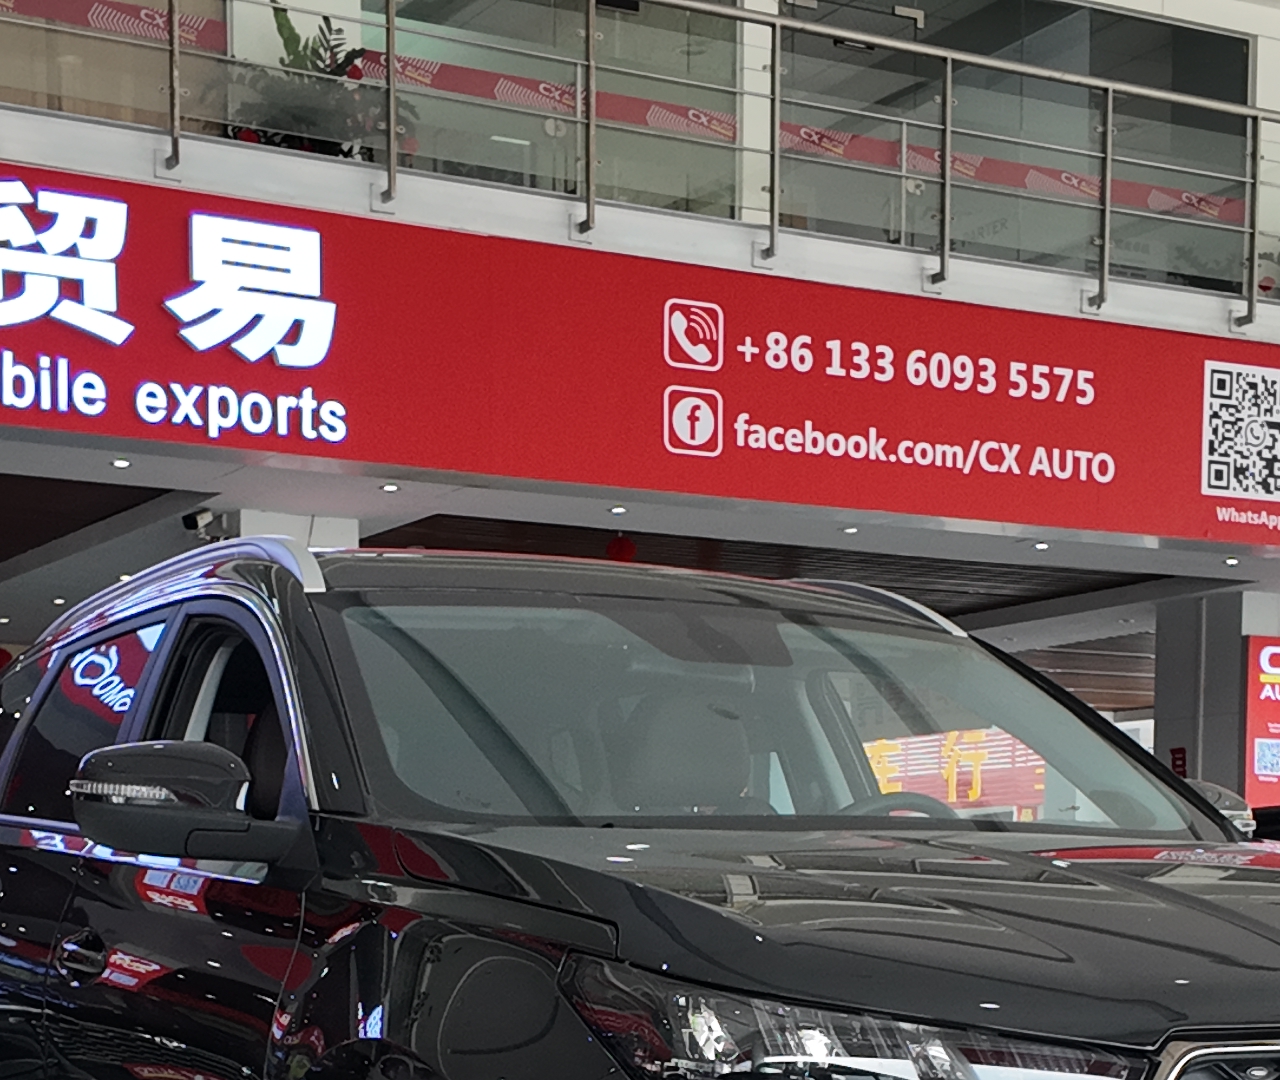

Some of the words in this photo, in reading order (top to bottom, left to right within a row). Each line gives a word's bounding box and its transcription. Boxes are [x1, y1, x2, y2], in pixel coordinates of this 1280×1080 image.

[736, 332, 814, 372] +86
[825, 339, 896, 382] 133
[906, 350, 997, 395] 6093
[1008, 362, 1096, 405] 5575
[135, 381, 348, 443] exports
[734, 413, 1021, 474] facebook.com/CX
[1029, 446, 1116, 483] AUTO
